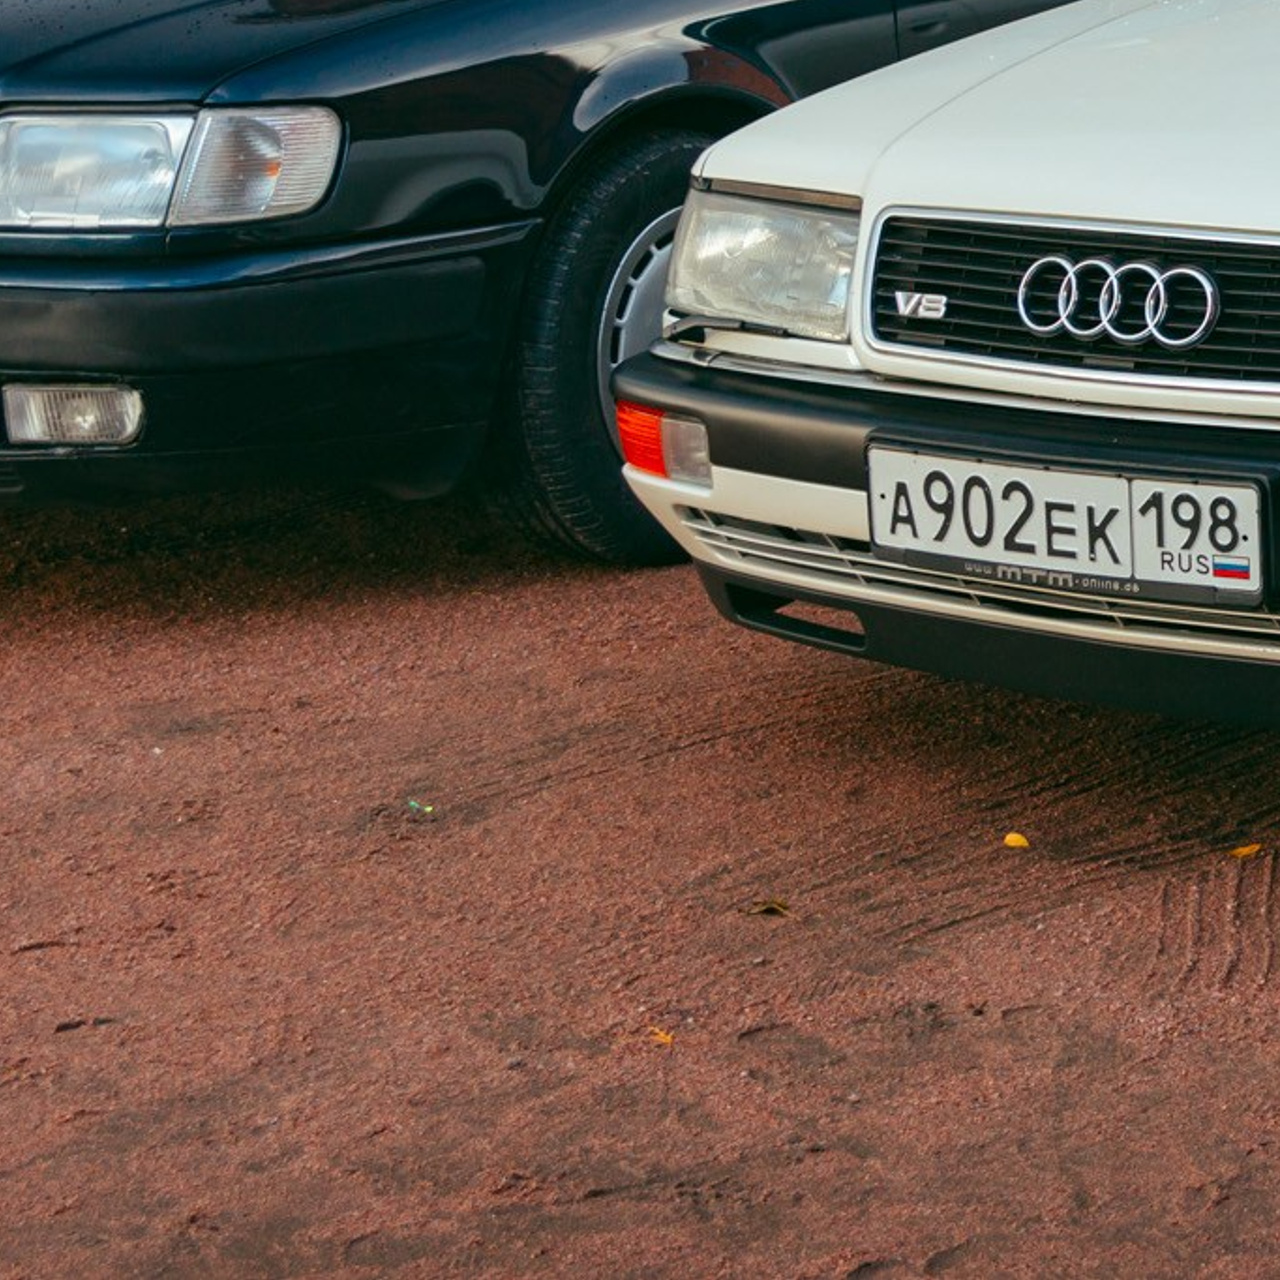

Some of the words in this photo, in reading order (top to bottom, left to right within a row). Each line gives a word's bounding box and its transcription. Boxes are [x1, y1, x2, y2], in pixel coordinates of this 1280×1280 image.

[895, 291, 948, 319] V8
[1138, 490, 1239, 553] 198
[1160, 551, 1210, 575] RUS
